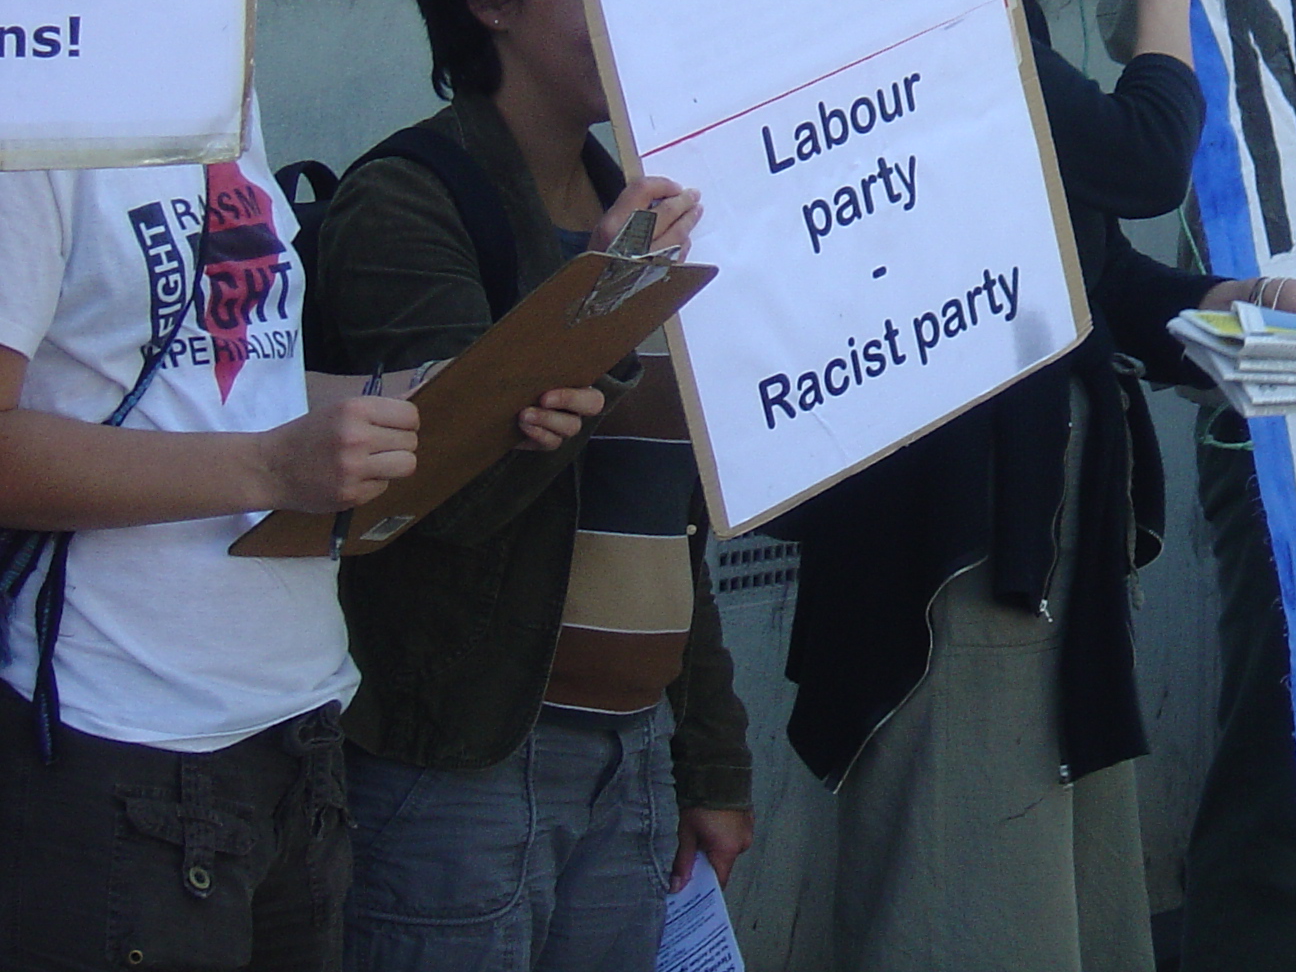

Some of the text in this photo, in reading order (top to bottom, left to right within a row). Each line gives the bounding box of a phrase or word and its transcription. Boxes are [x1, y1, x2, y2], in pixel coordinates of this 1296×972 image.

[761, 72, 921, 175] Labour
[802, 155, 916, 254] party
[758, 266, 1019, 430] Racist party
